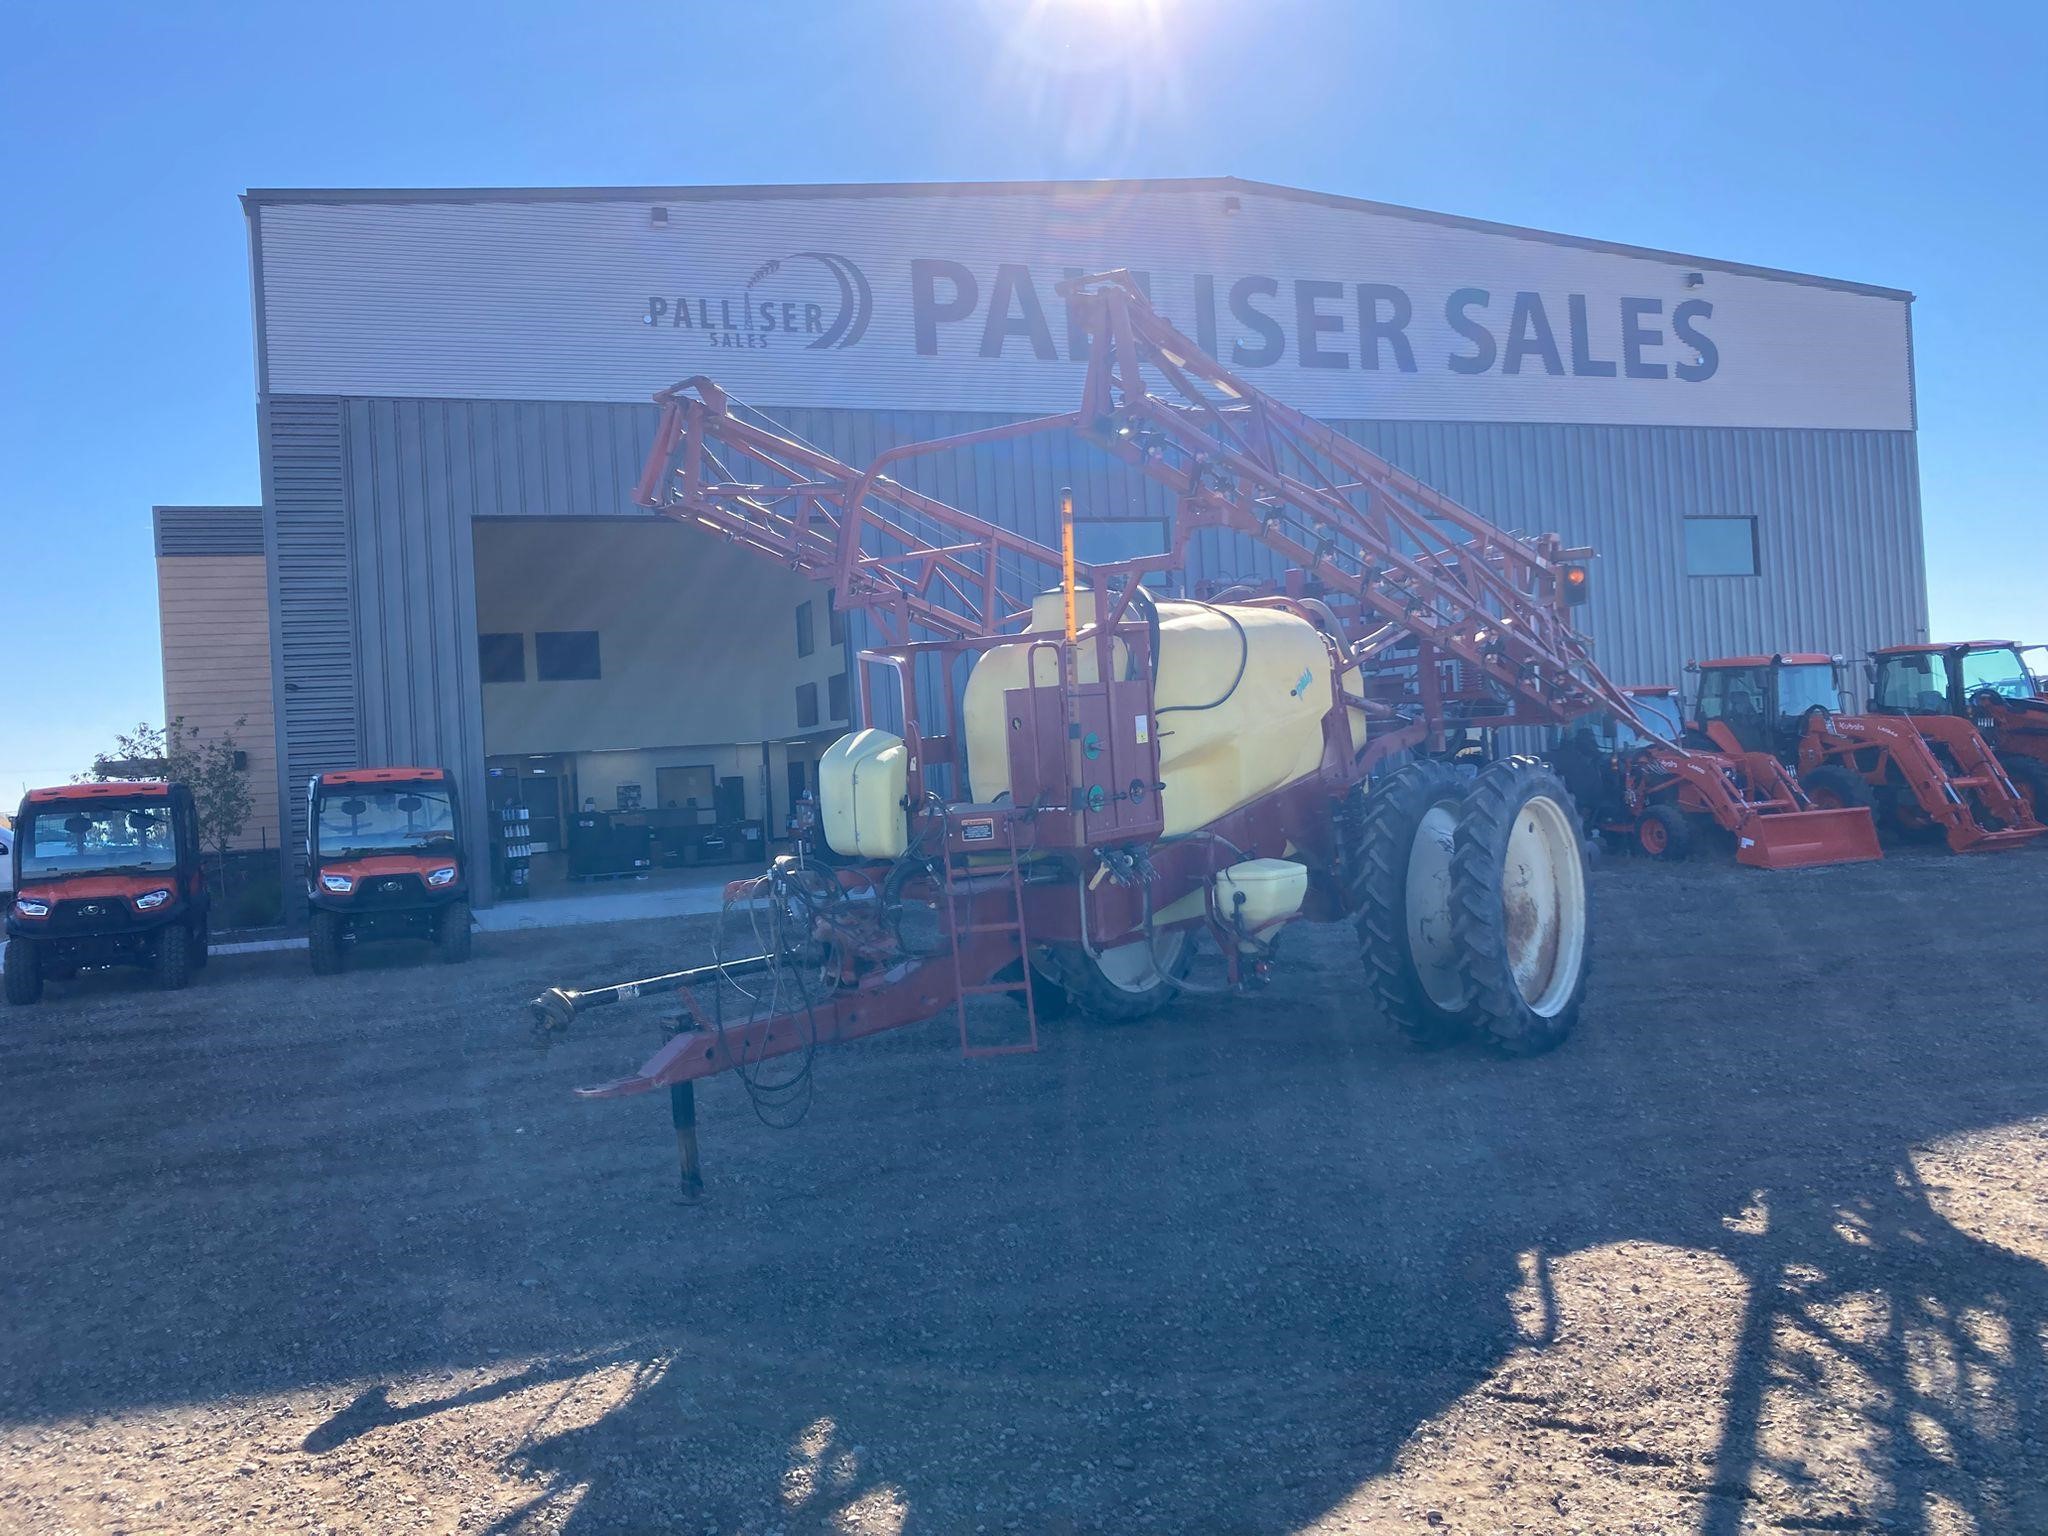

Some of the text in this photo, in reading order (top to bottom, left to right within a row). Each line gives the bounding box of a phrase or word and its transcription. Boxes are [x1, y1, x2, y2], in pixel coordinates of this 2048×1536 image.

[648, 295, 823, 333] PALLISER
[709, 332, 768, 348] SALES
[1445, 287, 1719, 382] SALES
